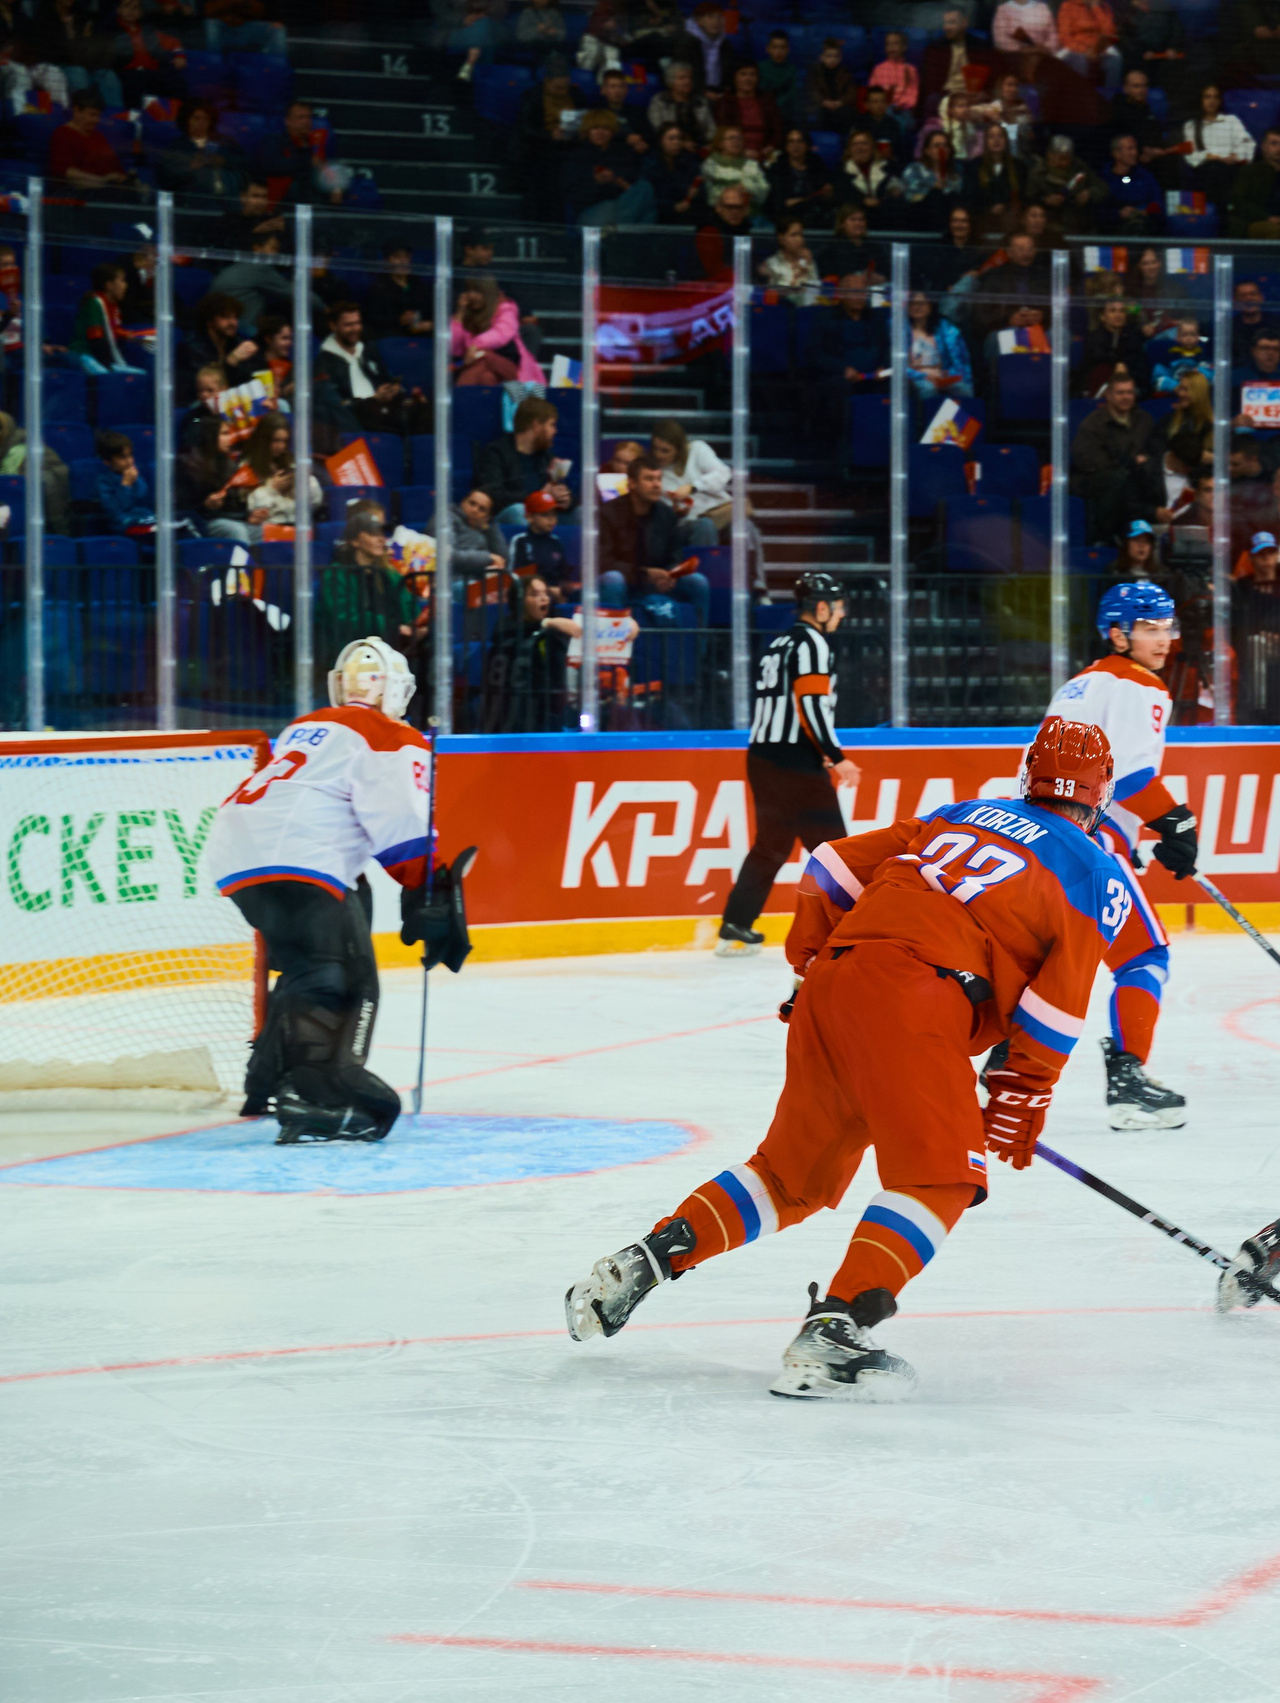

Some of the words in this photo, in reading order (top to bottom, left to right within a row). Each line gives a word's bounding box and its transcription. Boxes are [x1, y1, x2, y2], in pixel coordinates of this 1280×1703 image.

[381, 54, 409, 76] 14
[421, 113, 451, 135] 13
[467, 172, 497, 195] 12
[516, 236, 539, 259] 11
[1054, 777, 1076, 797] 33
[961, 806, 1049, 845] KORZIN
